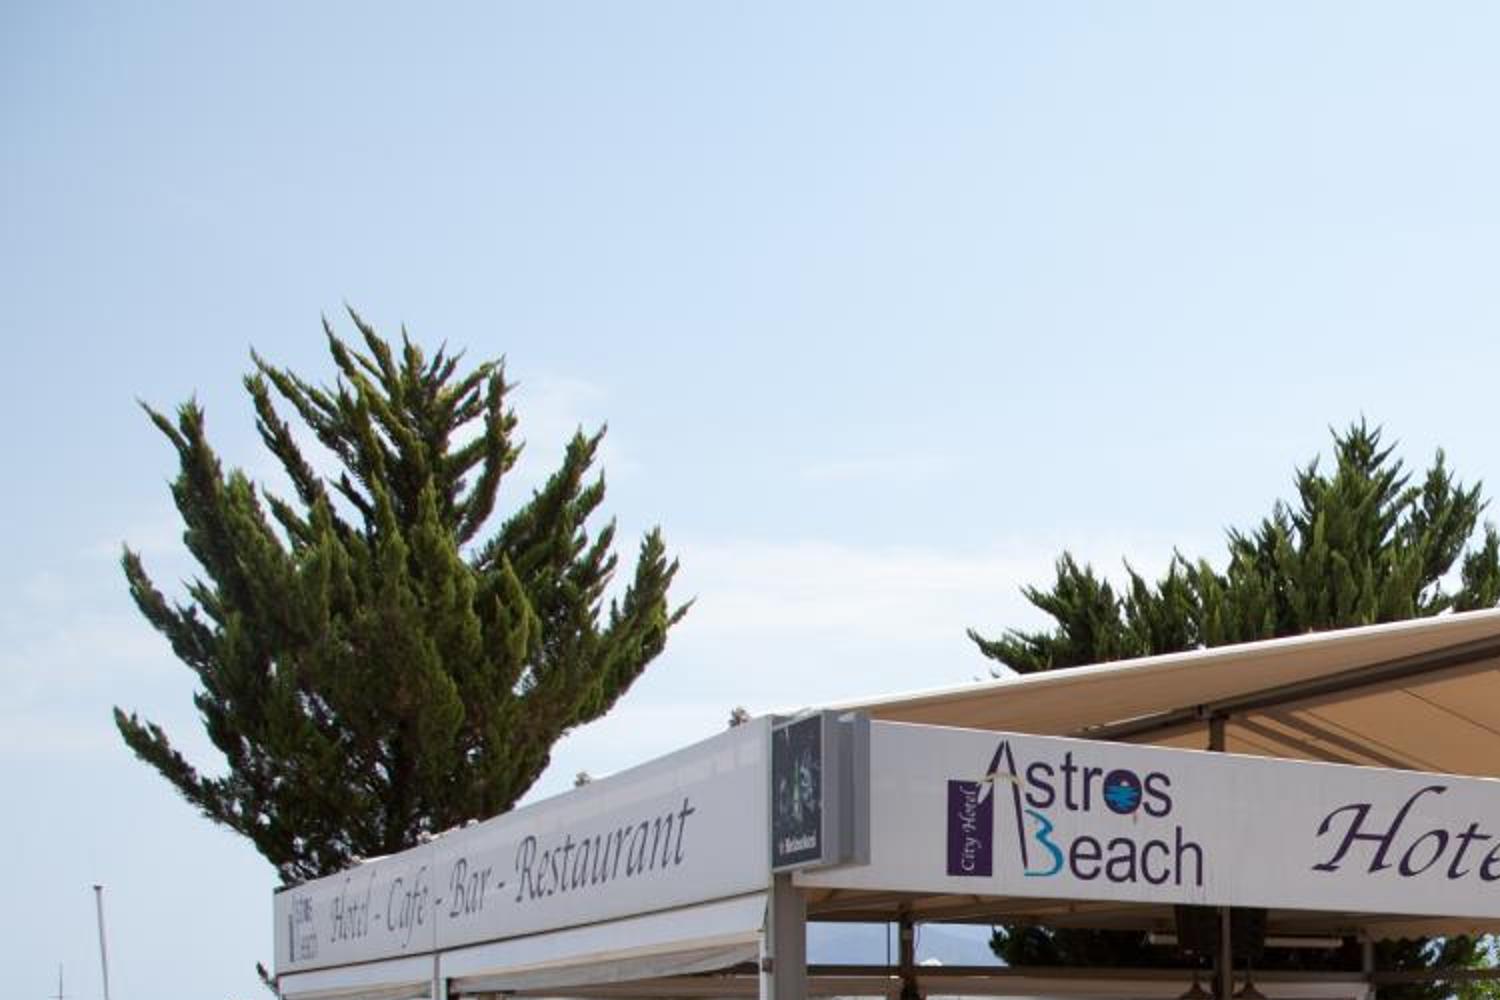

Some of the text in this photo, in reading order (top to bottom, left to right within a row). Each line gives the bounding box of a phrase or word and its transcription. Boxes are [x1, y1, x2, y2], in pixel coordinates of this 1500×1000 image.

[958, 785, 982, 871] City Hotel
[984, 740, 1172, 869] Astros
[1023, 809, 1203, 886] Beach
[331, 869, 377, 943] Hotel
[387, 865, 429, 949] Cafe
[449, 857, 493, 918] Bar
[515, 797, 696, 902] Restaurant
